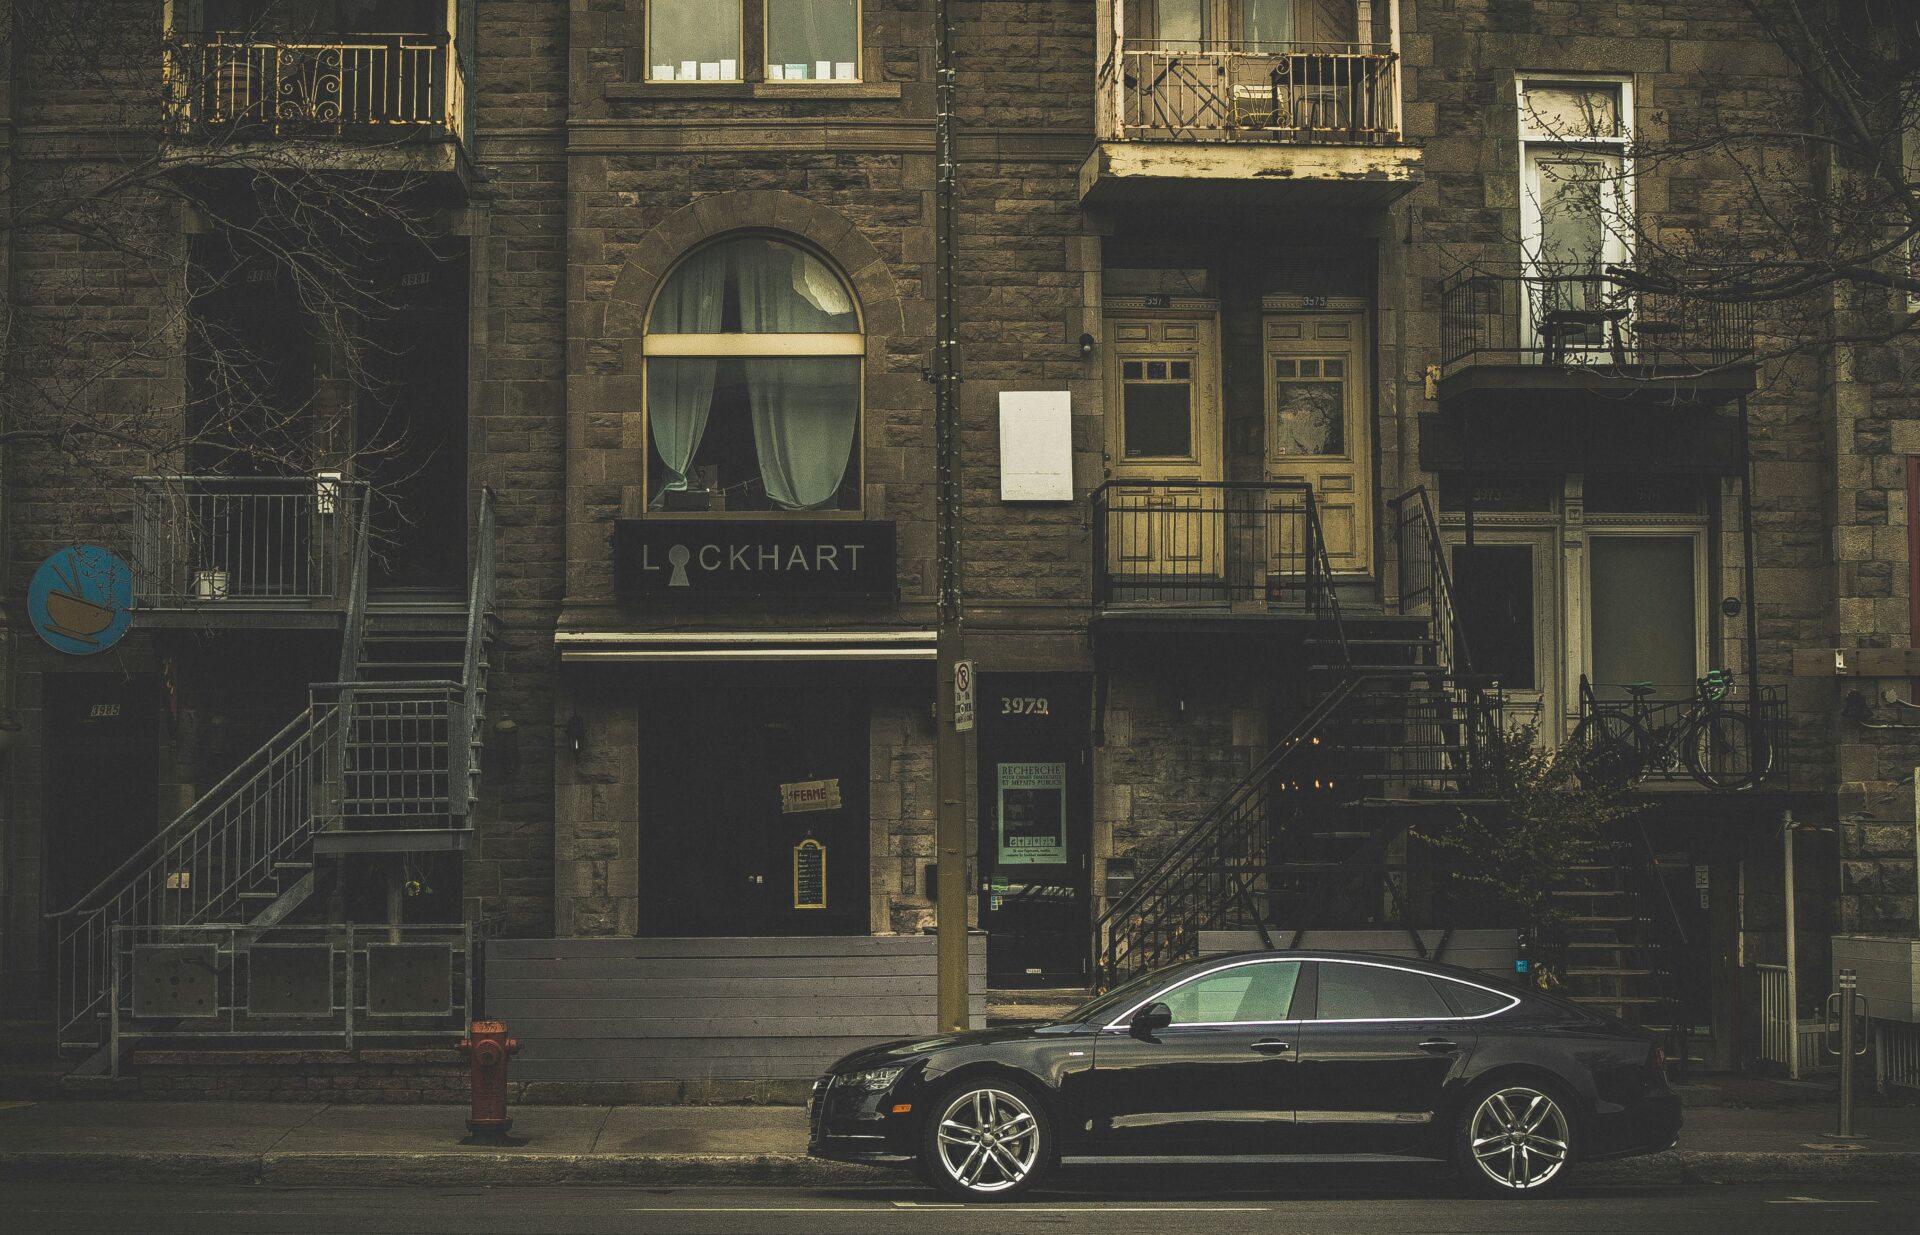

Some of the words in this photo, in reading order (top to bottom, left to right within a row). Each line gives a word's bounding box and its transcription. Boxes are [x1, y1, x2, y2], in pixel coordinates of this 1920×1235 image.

[643, 544, 865, 587] LOCKHART
[91, 703, 120, 717] 3985
[1001, 697, 1048, 715] 3979
